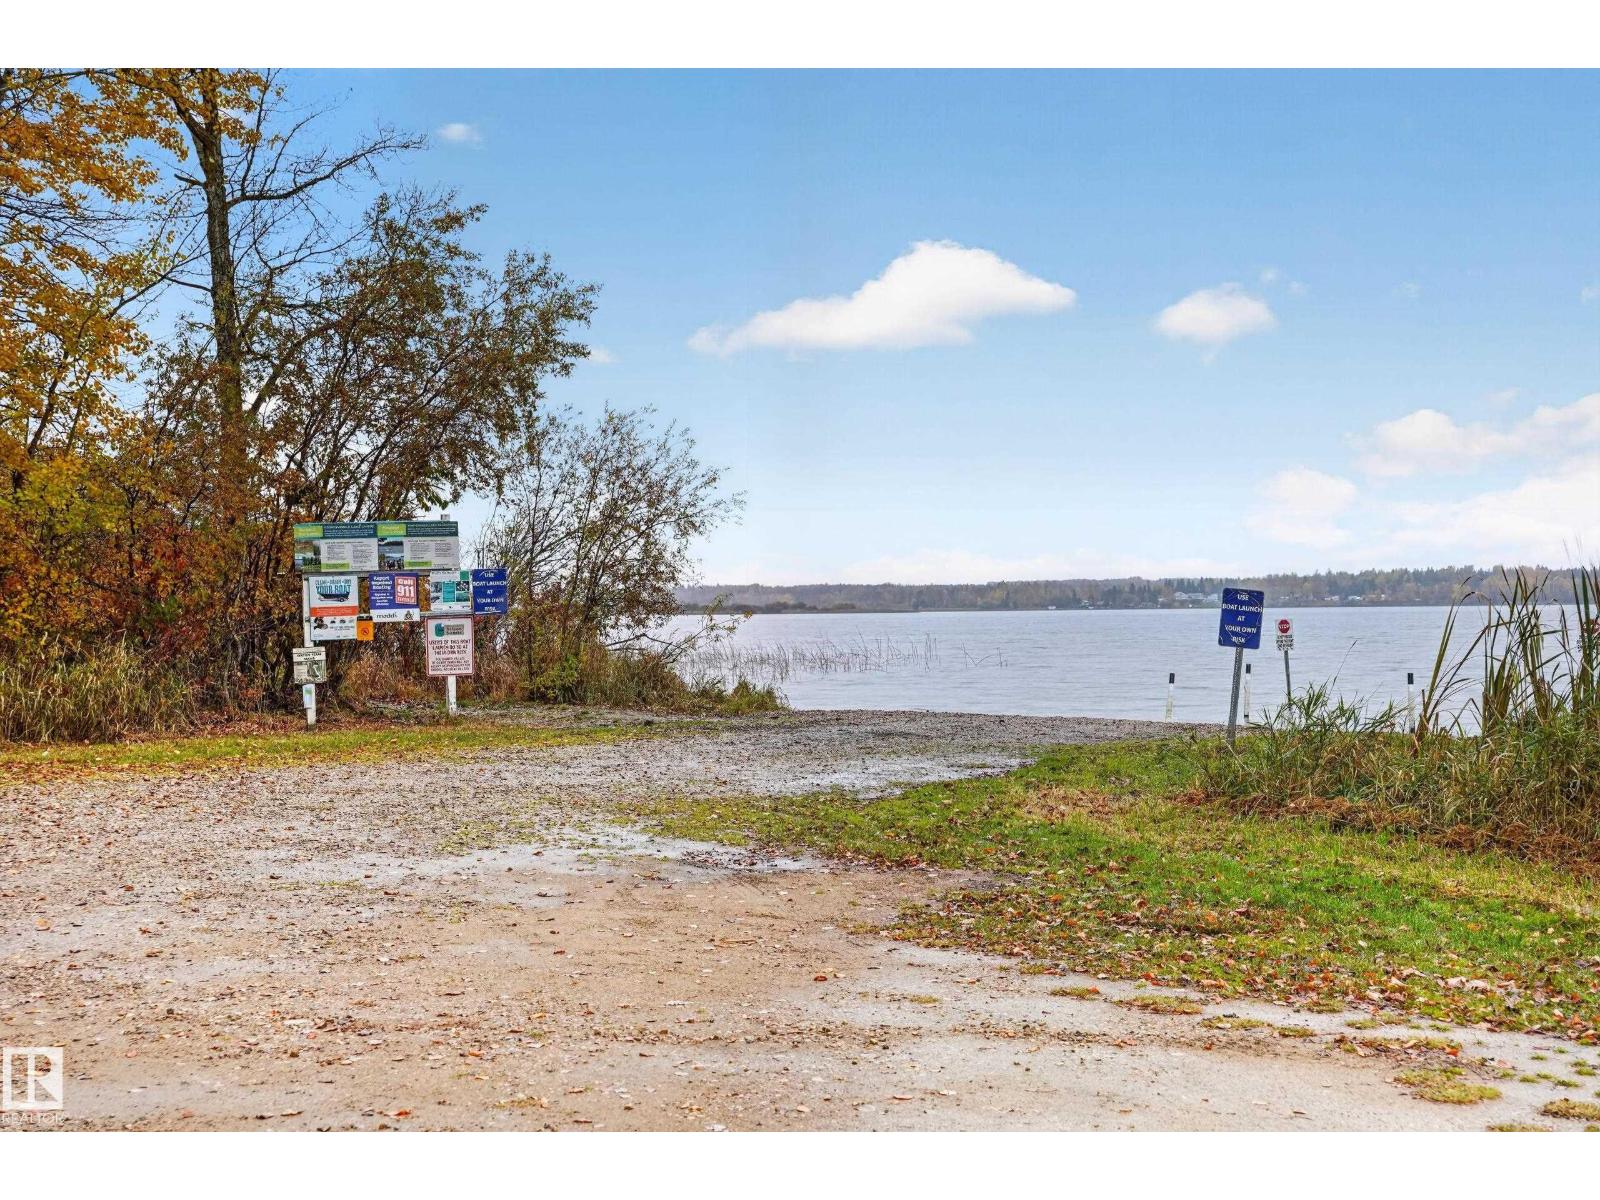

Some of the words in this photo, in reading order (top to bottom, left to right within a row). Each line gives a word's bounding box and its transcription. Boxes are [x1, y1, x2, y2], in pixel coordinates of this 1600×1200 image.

[316, 585, 332, 594] YOUR
[334, 584, 351, 593] BOAT
[398, 585, 414, 597] 911
